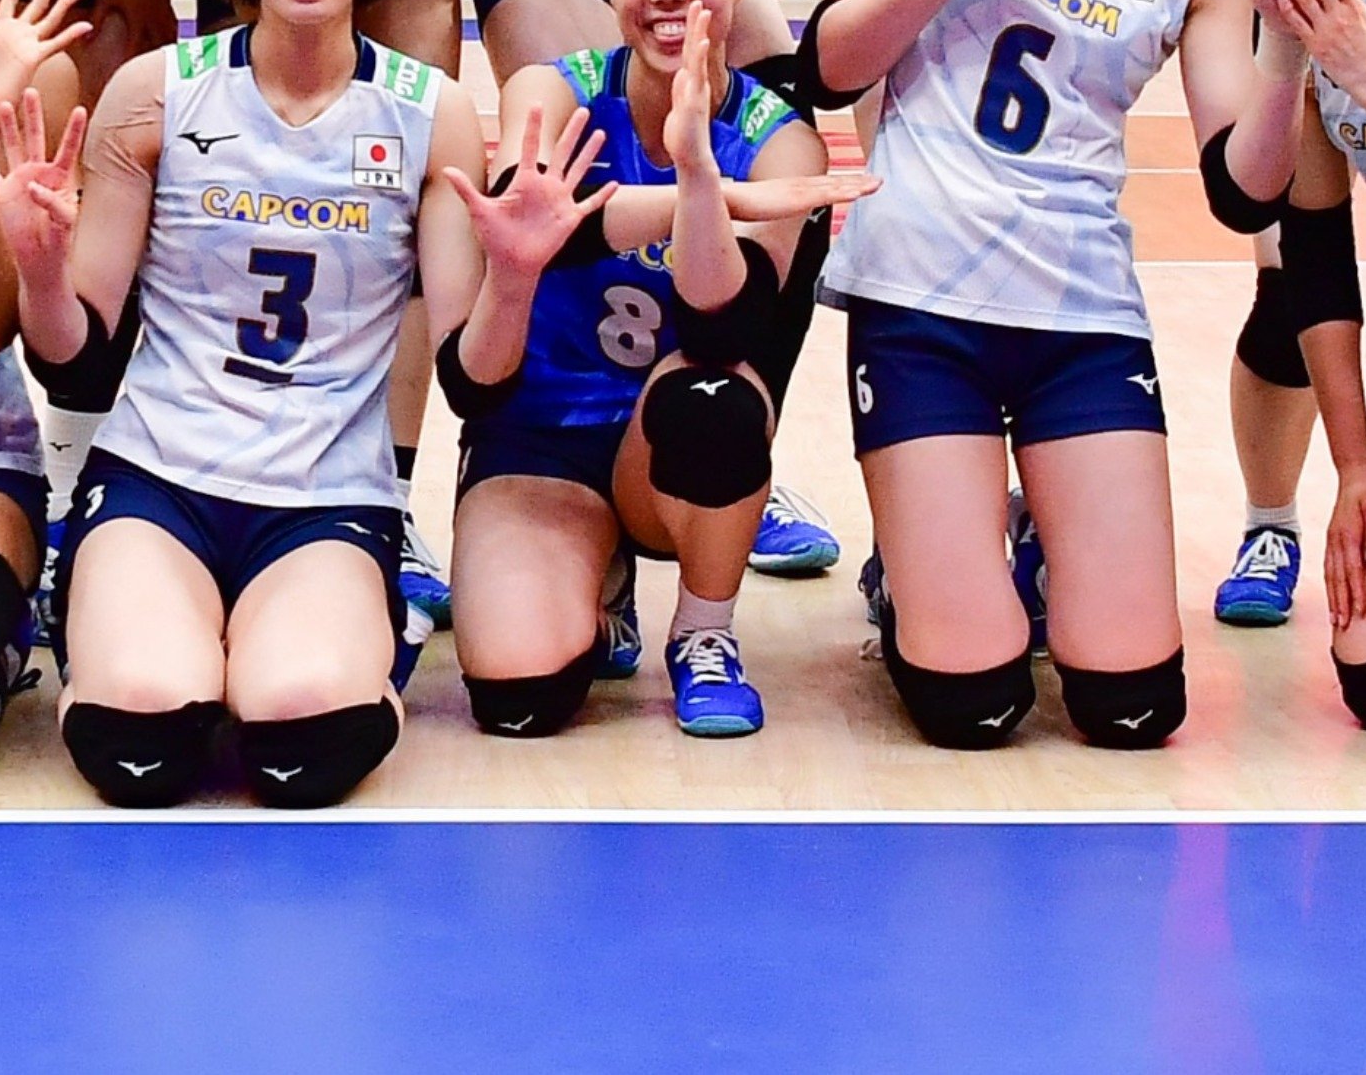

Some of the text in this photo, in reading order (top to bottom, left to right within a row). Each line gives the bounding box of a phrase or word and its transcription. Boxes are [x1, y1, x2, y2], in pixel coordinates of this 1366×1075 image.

[975, 23, 1057, 155] 6
[201, 186, 370, 233] CAPCOM
[363, 172, 394, 186] JPN
[236, 247, 317, 365] 3
[597, 285, 663, 368] 8
[856, 363, 874, 414] 6
